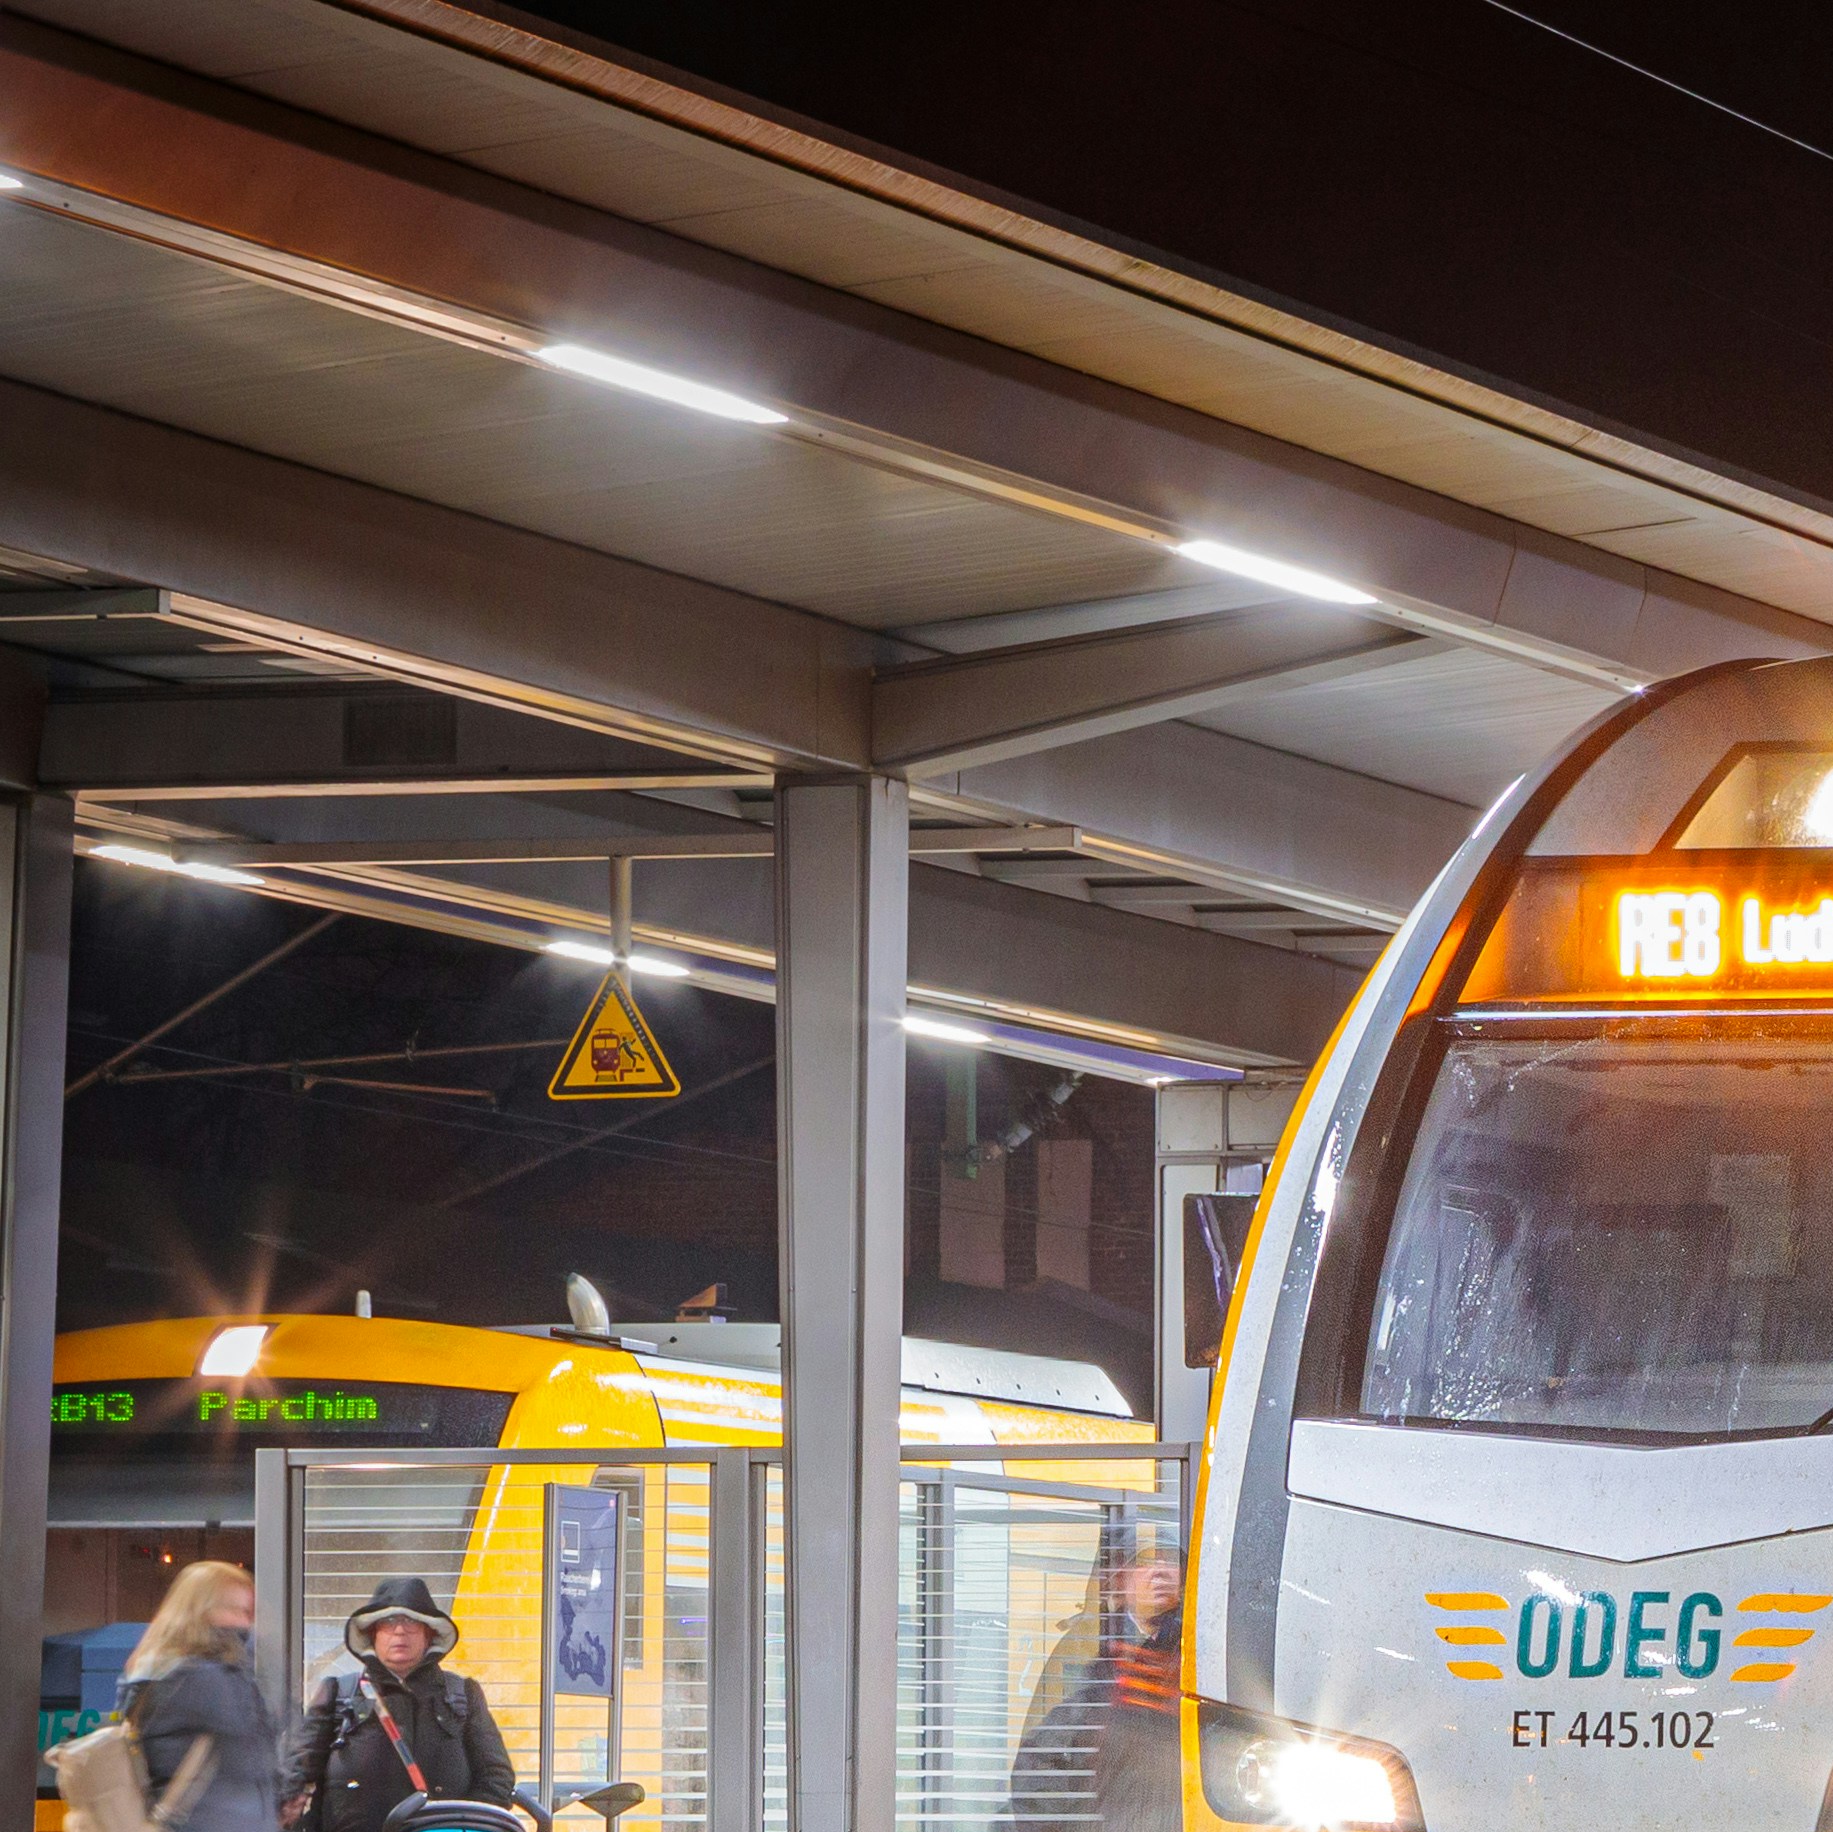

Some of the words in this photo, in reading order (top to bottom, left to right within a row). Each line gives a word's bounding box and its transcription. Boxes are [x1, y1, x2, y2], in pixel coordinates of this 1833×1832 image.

[200, 1391, 379, 1421] Parchim
[1516, 1591, 1723, 1679] ODEG
[1512, 1710, 1556, 1748] ET
[1568, 1711, 1715, 1749] 445.102
